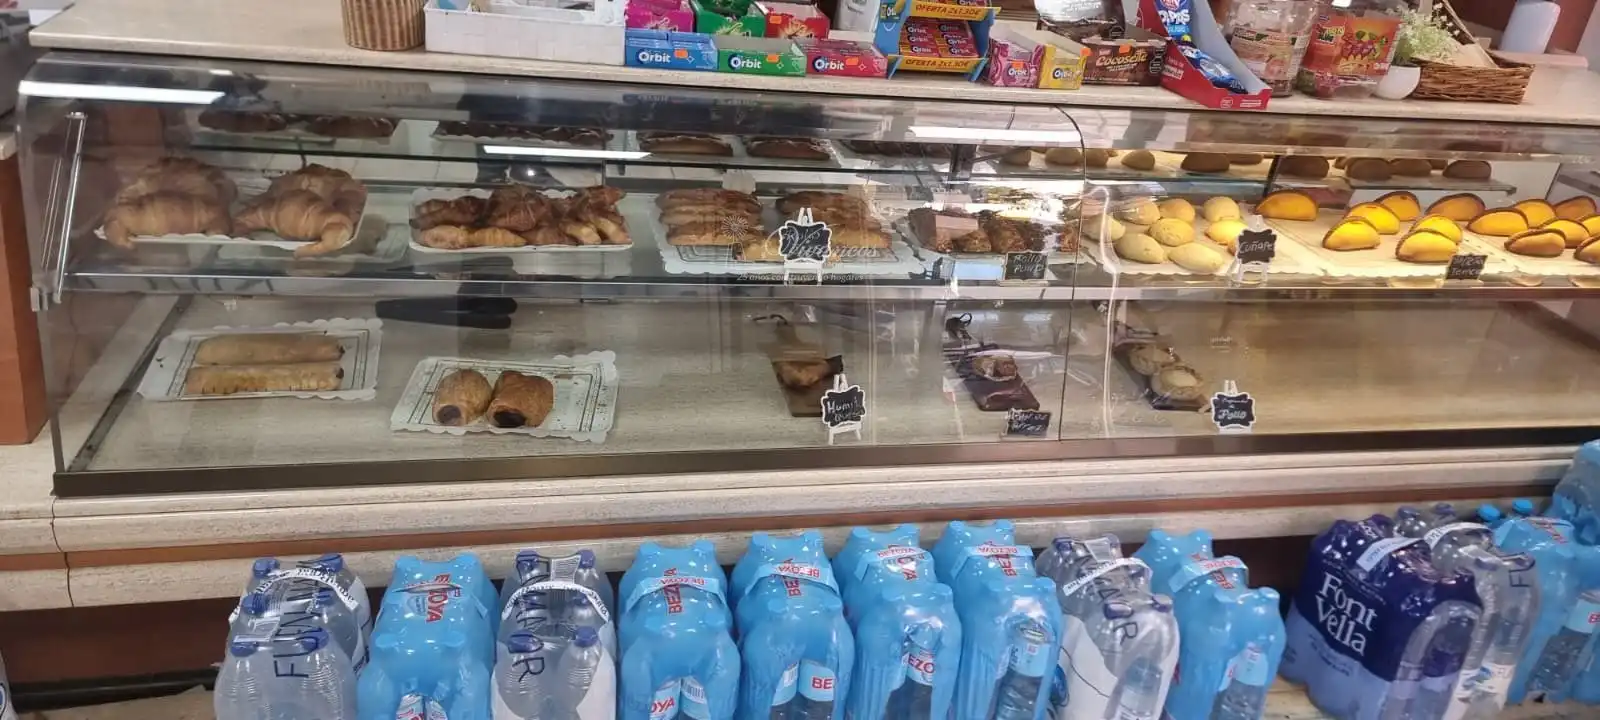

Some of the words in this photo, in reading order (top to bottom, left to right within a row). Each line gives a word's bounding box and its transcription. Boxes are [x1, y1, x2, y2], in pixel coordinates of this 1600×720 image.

[915, 5, 947, 14] OFERTA
[638, 50, 671, 63] Orbit
[730, 55, 762, 69] Orbit
[813, 58, 845, 71] Orbit
[906, 59, 936, 69] OFERTA
[1319, 572, 1378, 632] Font
[1315, 594, 1367, 657] Vella
